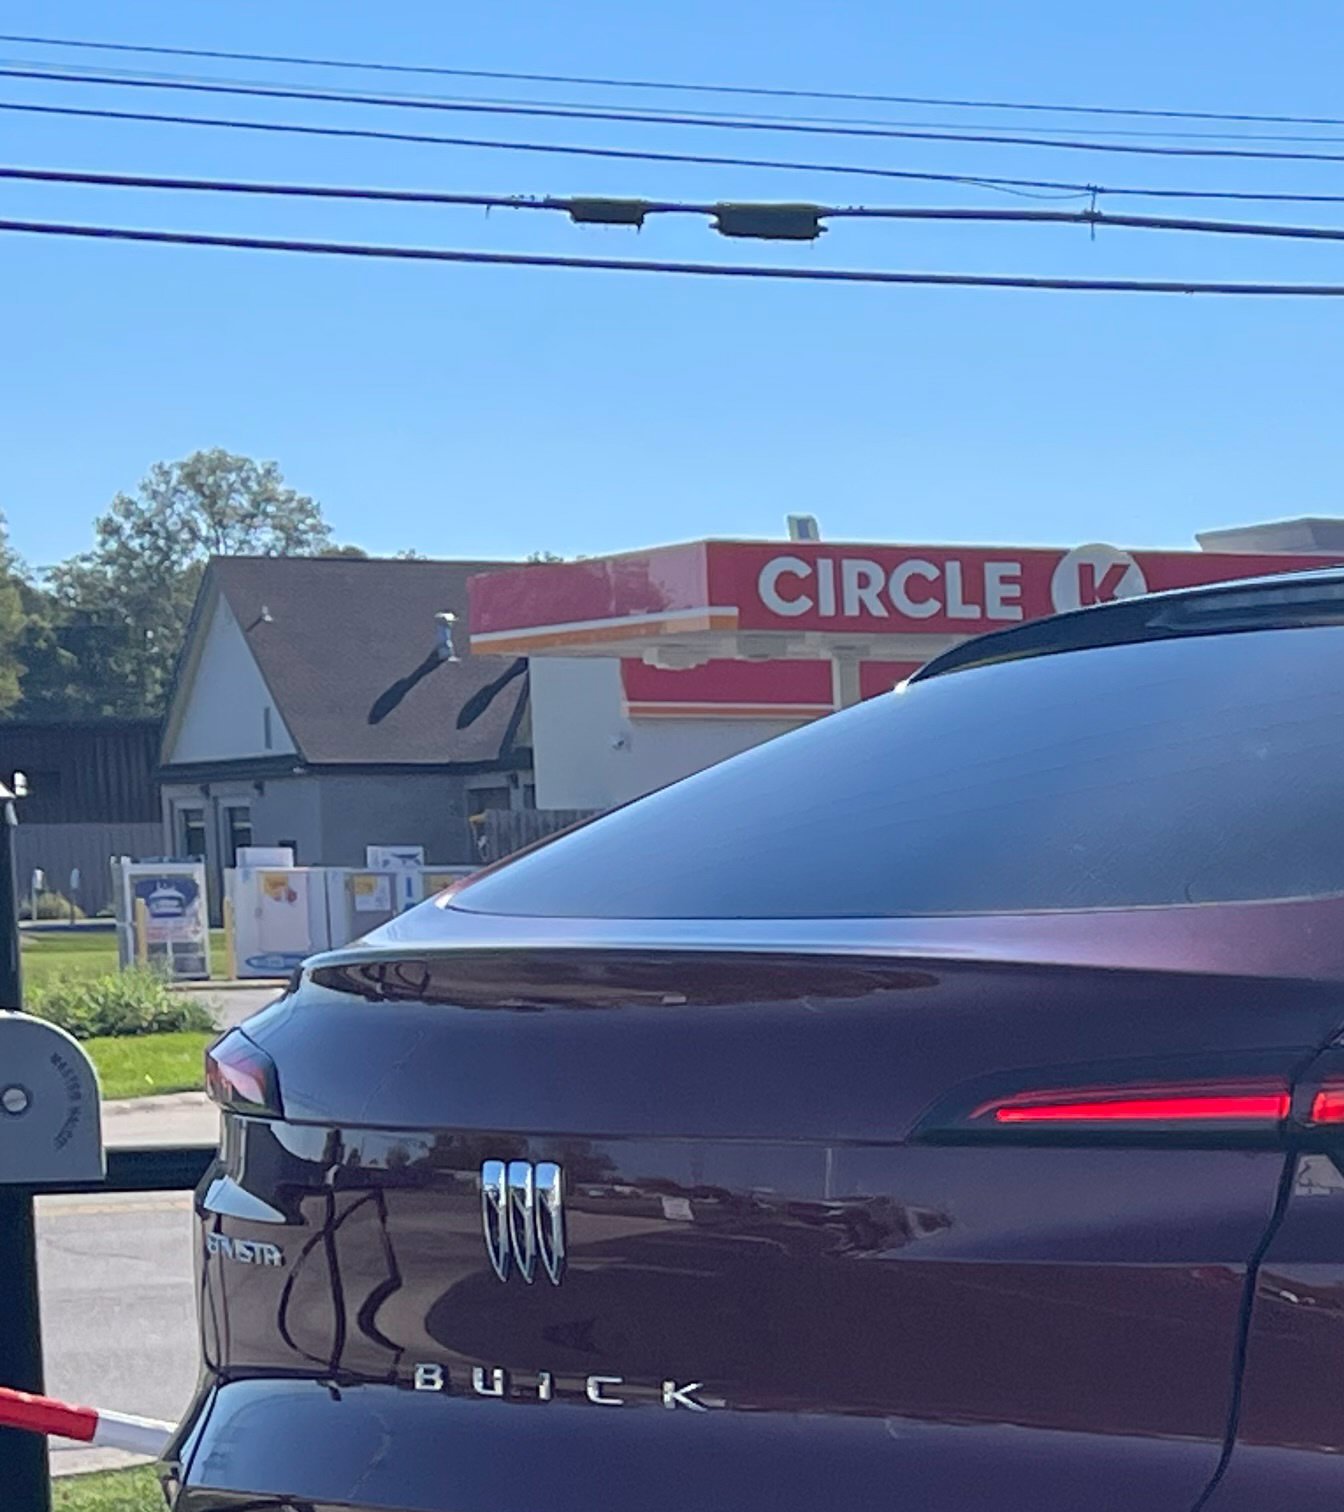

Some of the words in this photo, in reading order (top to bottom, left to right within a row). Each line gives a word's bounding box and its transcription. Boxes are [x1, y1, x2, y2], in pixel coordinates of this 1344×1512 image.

[758, 556, 1024, 620] CIRCLE
[1078, 563, 1131, 604] K
[414, 1363, 707, 1411] BUICK
